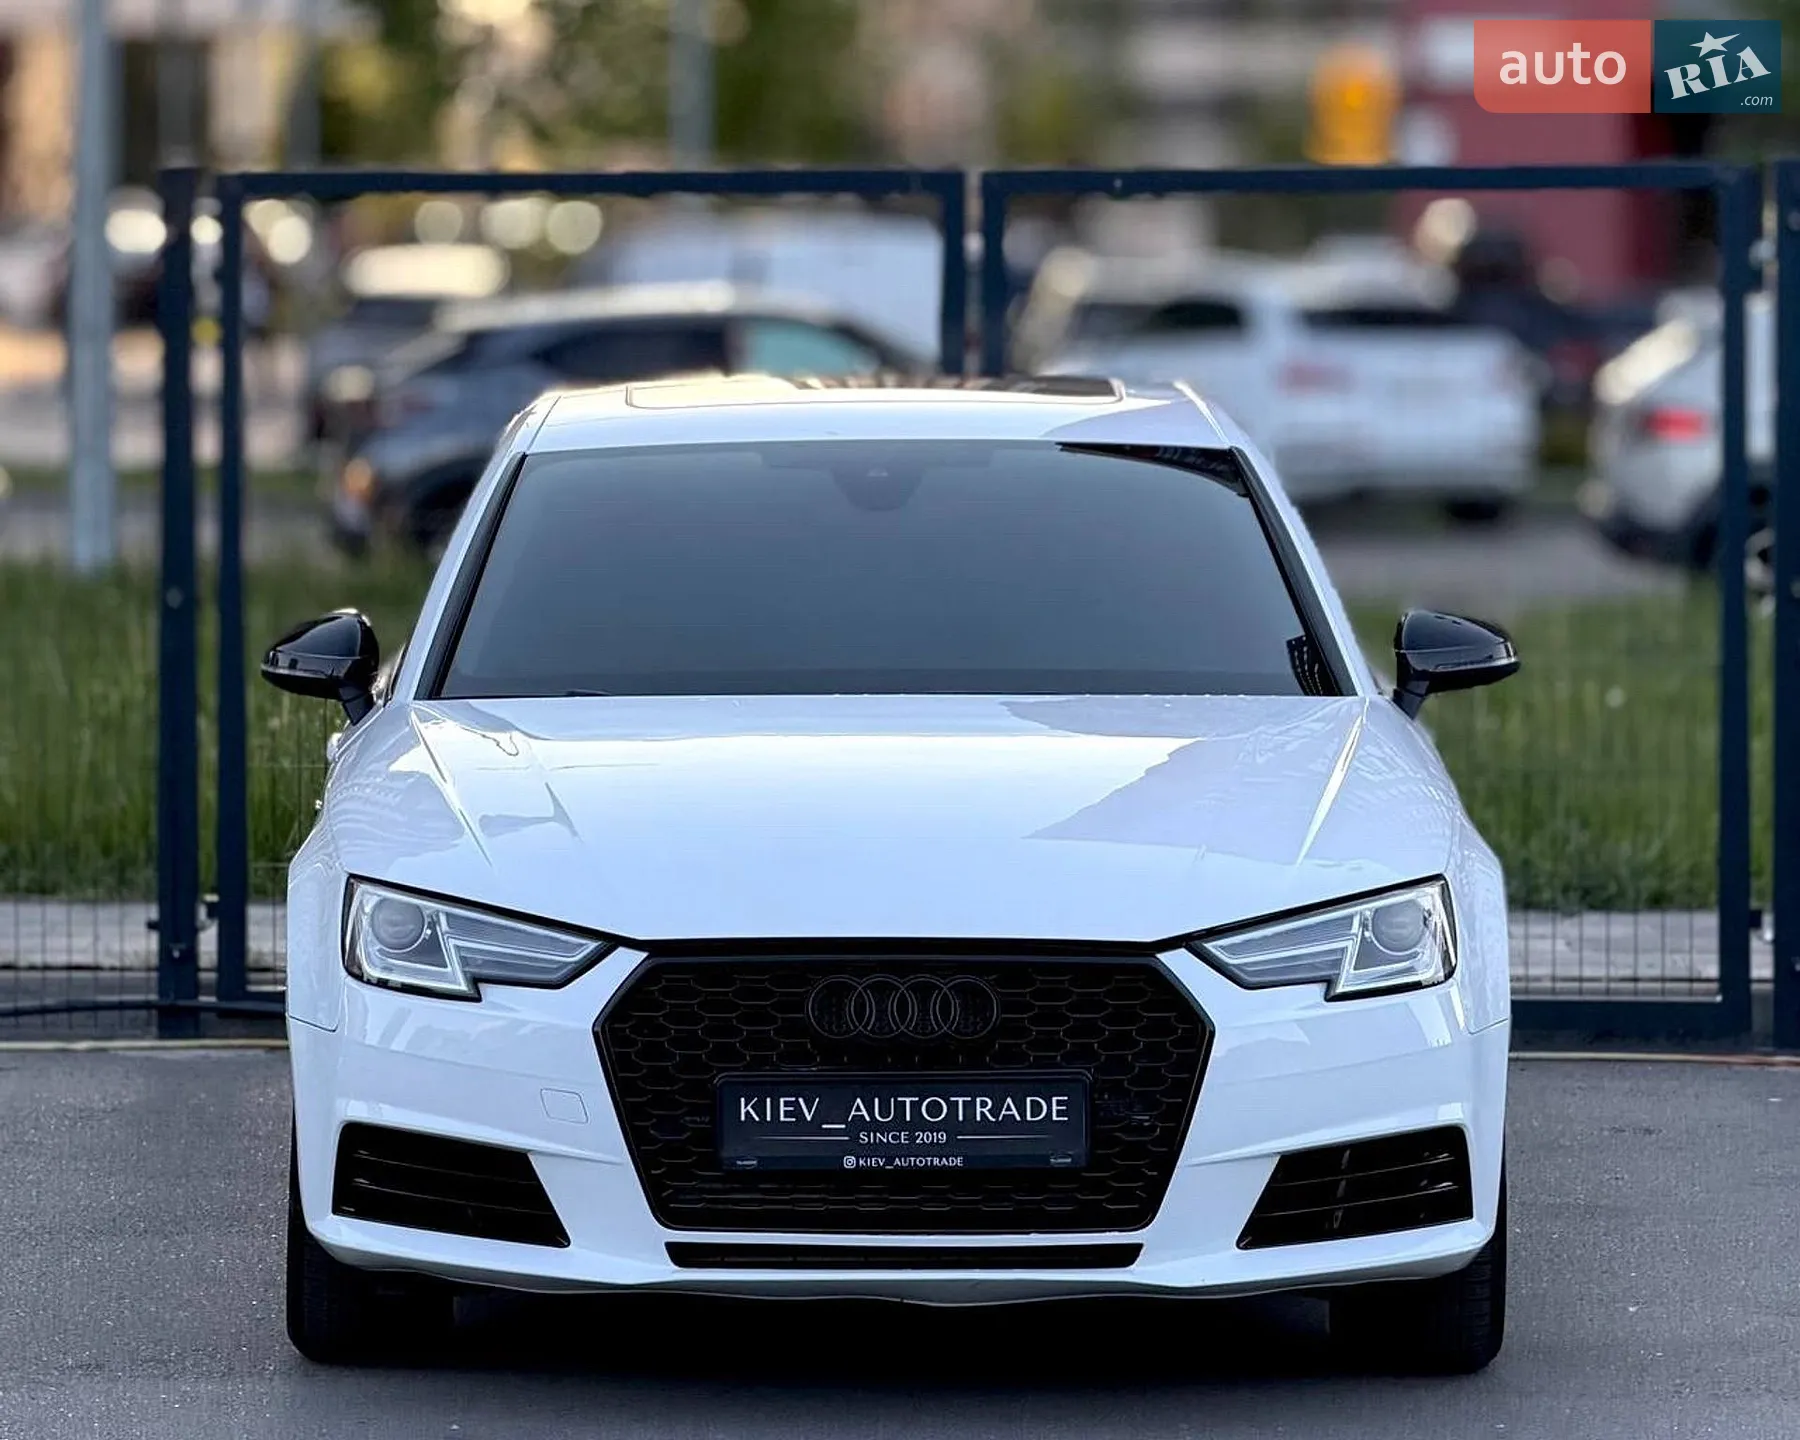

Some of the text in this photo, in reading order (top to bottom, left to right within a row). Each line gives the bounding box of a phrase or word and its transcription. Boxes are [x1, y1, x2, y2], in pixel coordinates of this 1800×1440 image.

[739, 1096, 1070, 1128] KIEV_AUTOTRADE
[859, 1131, 947, 1144] SINCE 2019
[859, 1156, 964, 1169] KIEV_AUTOTRADE
